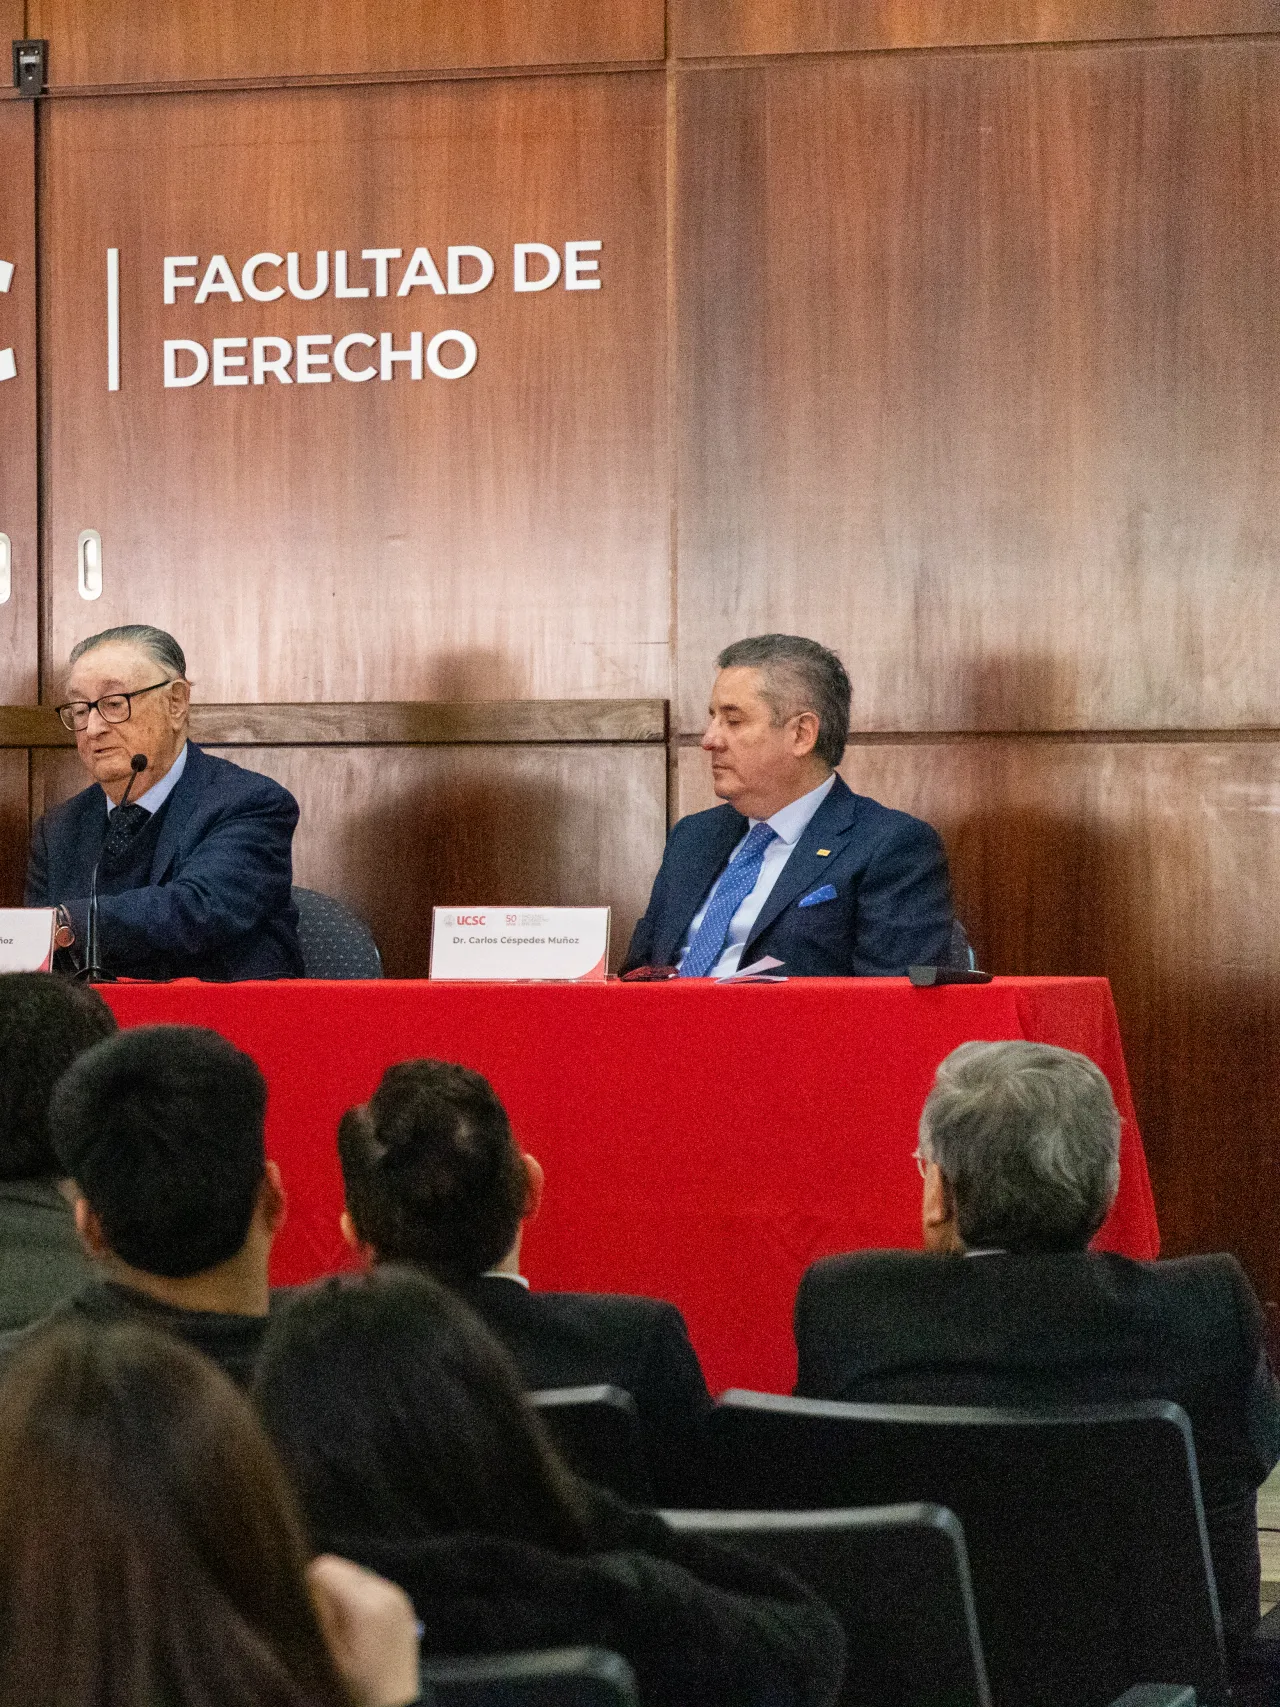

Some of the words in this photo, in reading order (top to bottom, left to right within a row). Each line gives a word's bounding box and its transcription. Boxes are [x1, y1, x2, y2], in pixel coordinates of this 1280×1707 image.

[163, 244, 495, 304] FACULTAD
[513, 240, 602, 293] DE
[163, 329, 478, 388] DERECHO
[456, 915, 486, 926] UCSC
[506, 914, 517, 923] 50
[468, 936, 498, 944] Carlos
[500, 936, 546, 945] Céspedes
[548, 936, 580, 944] Muñoz
